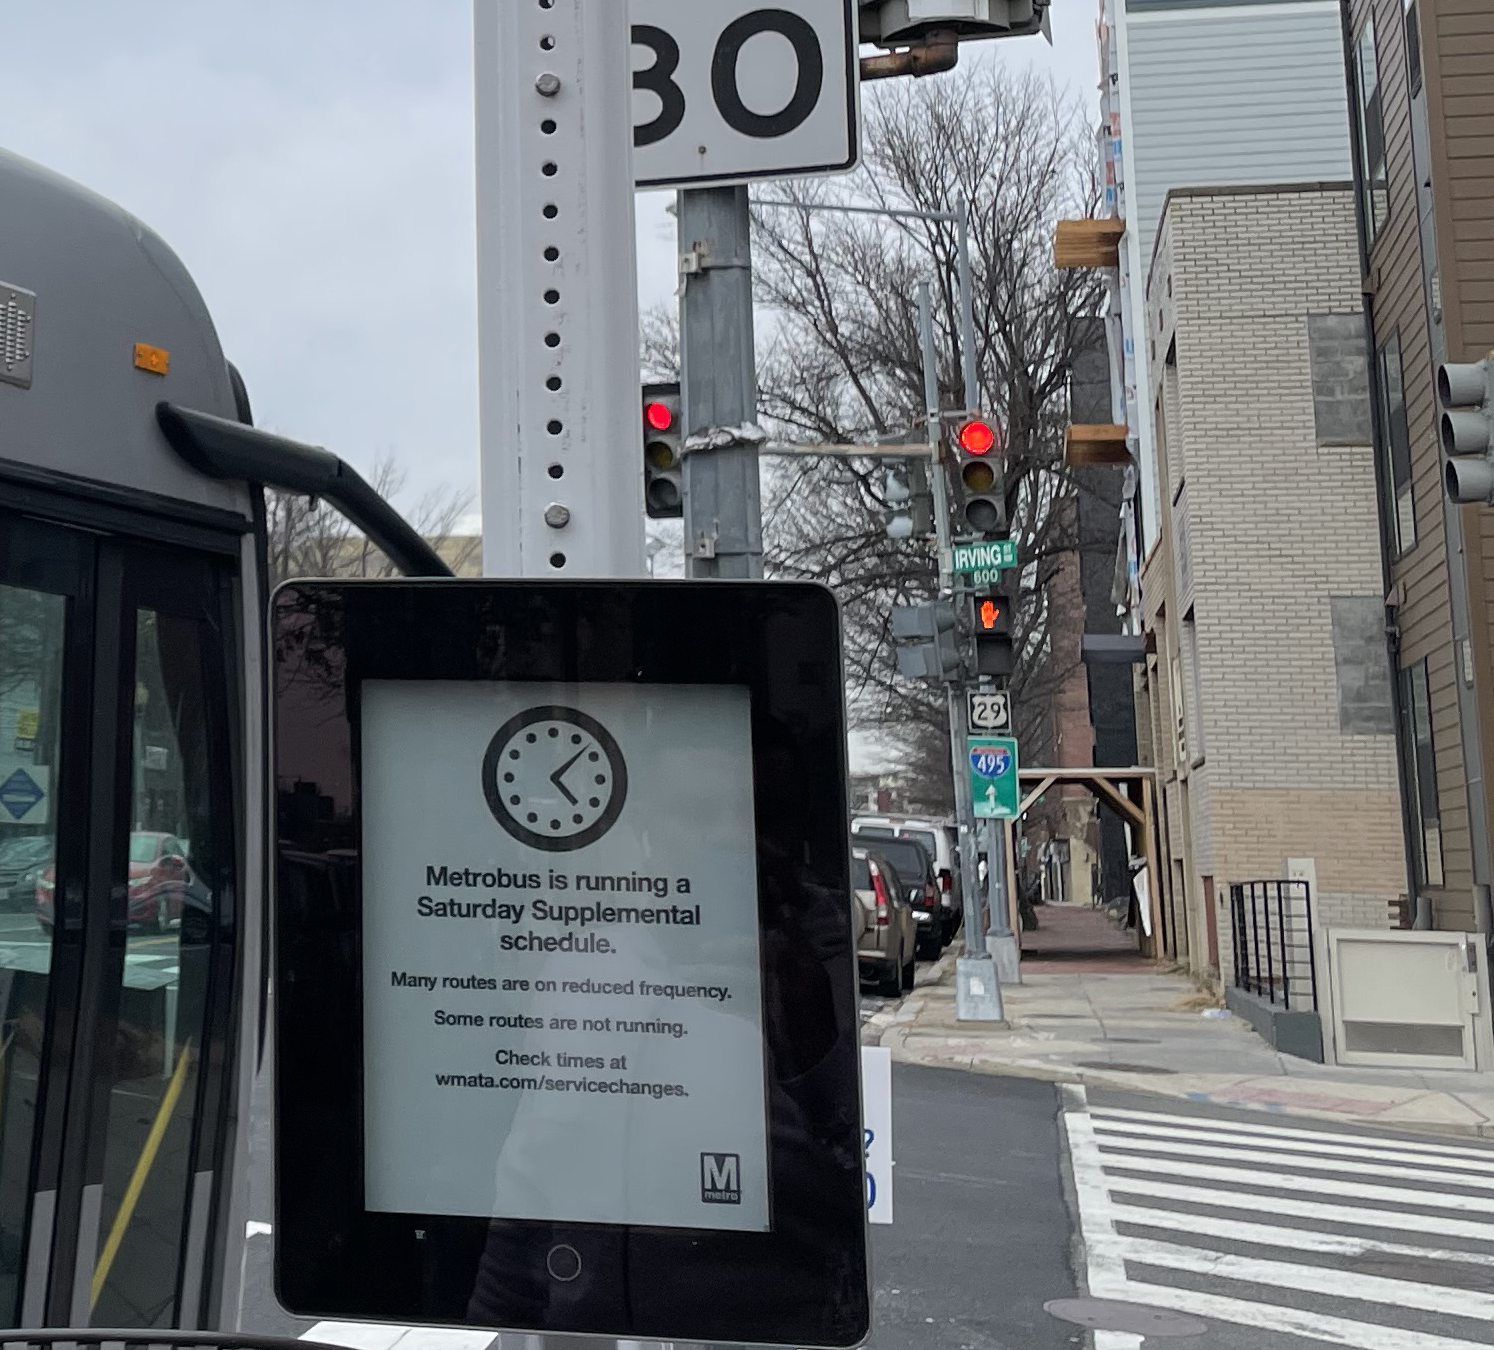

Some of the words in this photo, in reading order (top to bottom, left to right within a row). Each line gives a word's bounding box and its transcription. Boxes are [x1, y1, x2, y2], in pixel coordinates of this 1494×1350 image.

[630, 8, 824, 148] 30
[954, 544, 1002, 570] IRVING
[973, 567, 999, 585] 600
[977, 701, 1002, 721] 29
[977, 753, 1006, 775] 495
[425, 865, 542, 891] Metrobus
[548, 868, 569, 891] is
[575, 870, 669, 898] running
[675, 876, 692, 894] a
[416, 896, 525, 925] Saturday
[531, 899, 702, 927] Supplemental
[499, 930, 617, 955] schedule.
[390, 970, 438, 992] Many
[442, 974, 497, 992] routes
[501, 978, 530, 992] are
[534, 979, 557, 993] on
[561, 978, 635, 996] reduced
[639, 980, 733, 1002] frequency.
[433, 1009, 485, 1028] Some
[488, 1013, 545, 1030] routes
[549, 1016, 578, 1031] are
[582, 1016, 612, 1033] not
[615, 1017, 689, 1039] running.
[494, 1049, 553, 1068] Check
[556, 1052, 606, 1070] times
[609, 1054, 628, 1071] at
[434, 1073, 690, 1100] wmata.com/servicechanges.
[703, 1154, 738, 1191] M
[704, 1190, 740, 1202] metro
